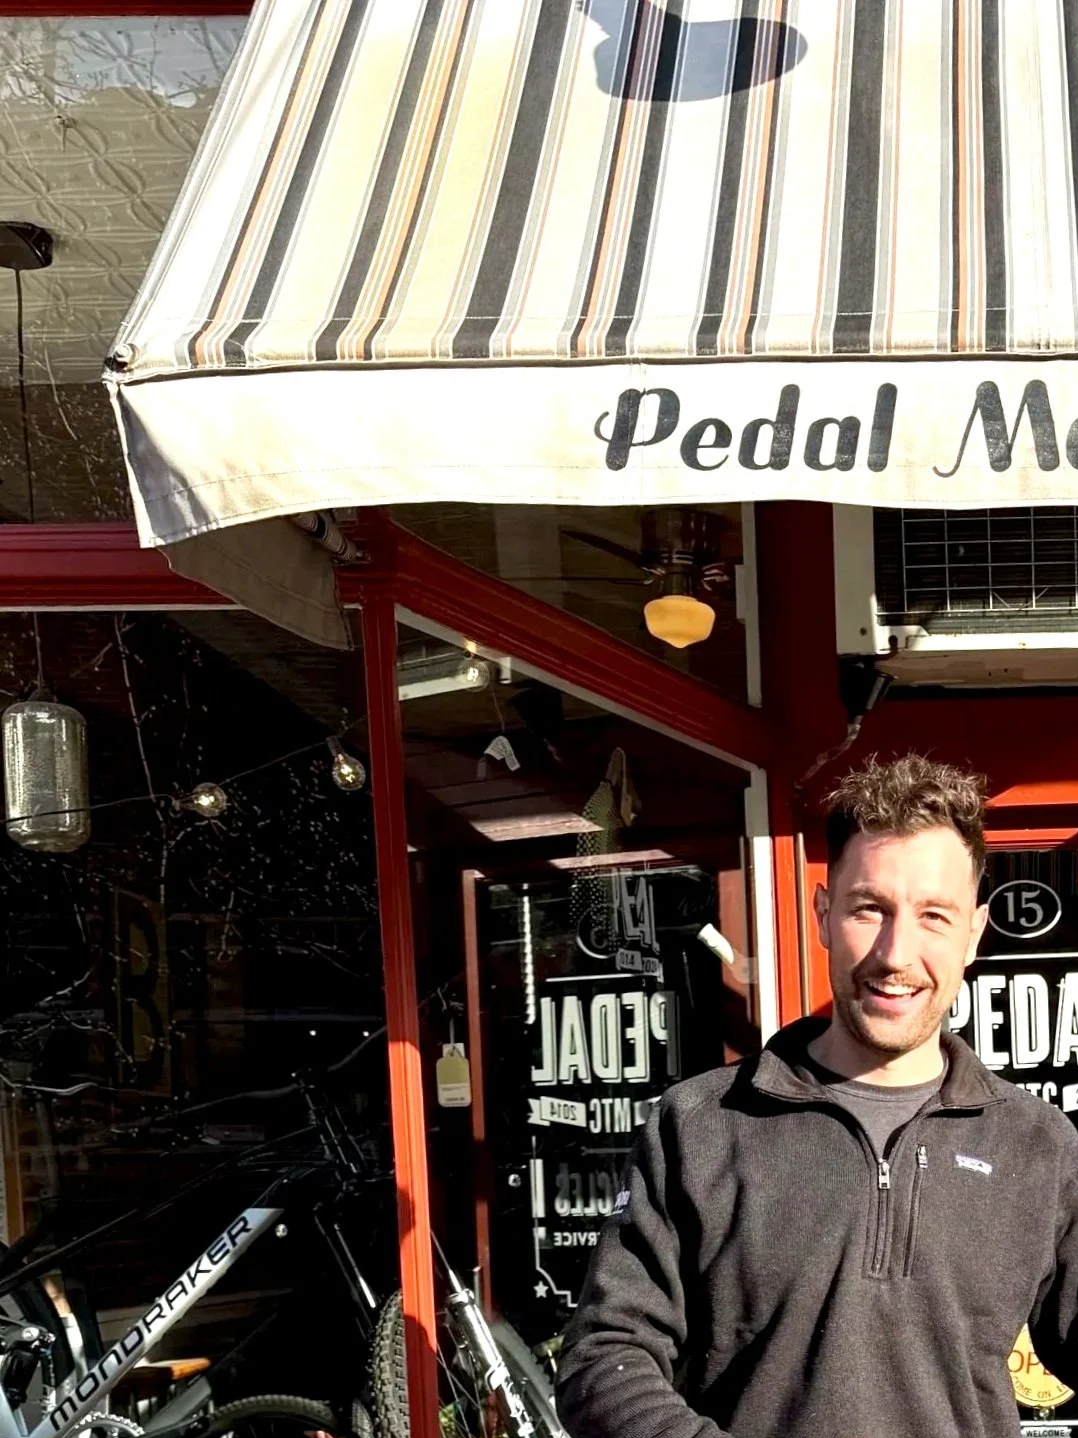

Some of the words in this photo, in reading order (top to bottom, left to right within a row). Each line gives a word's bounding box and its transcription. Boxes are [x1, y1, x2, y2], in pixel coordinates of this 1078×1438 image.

[594, 382, 898, 472] Pedal
[1003, 888, 1044, 928] 15
[1019, 1080, 1058, 1107] TC
[50, 1214, 254, 1432] MONDRAKER
[1026, 1429, 1065, 1438] WELCOME
